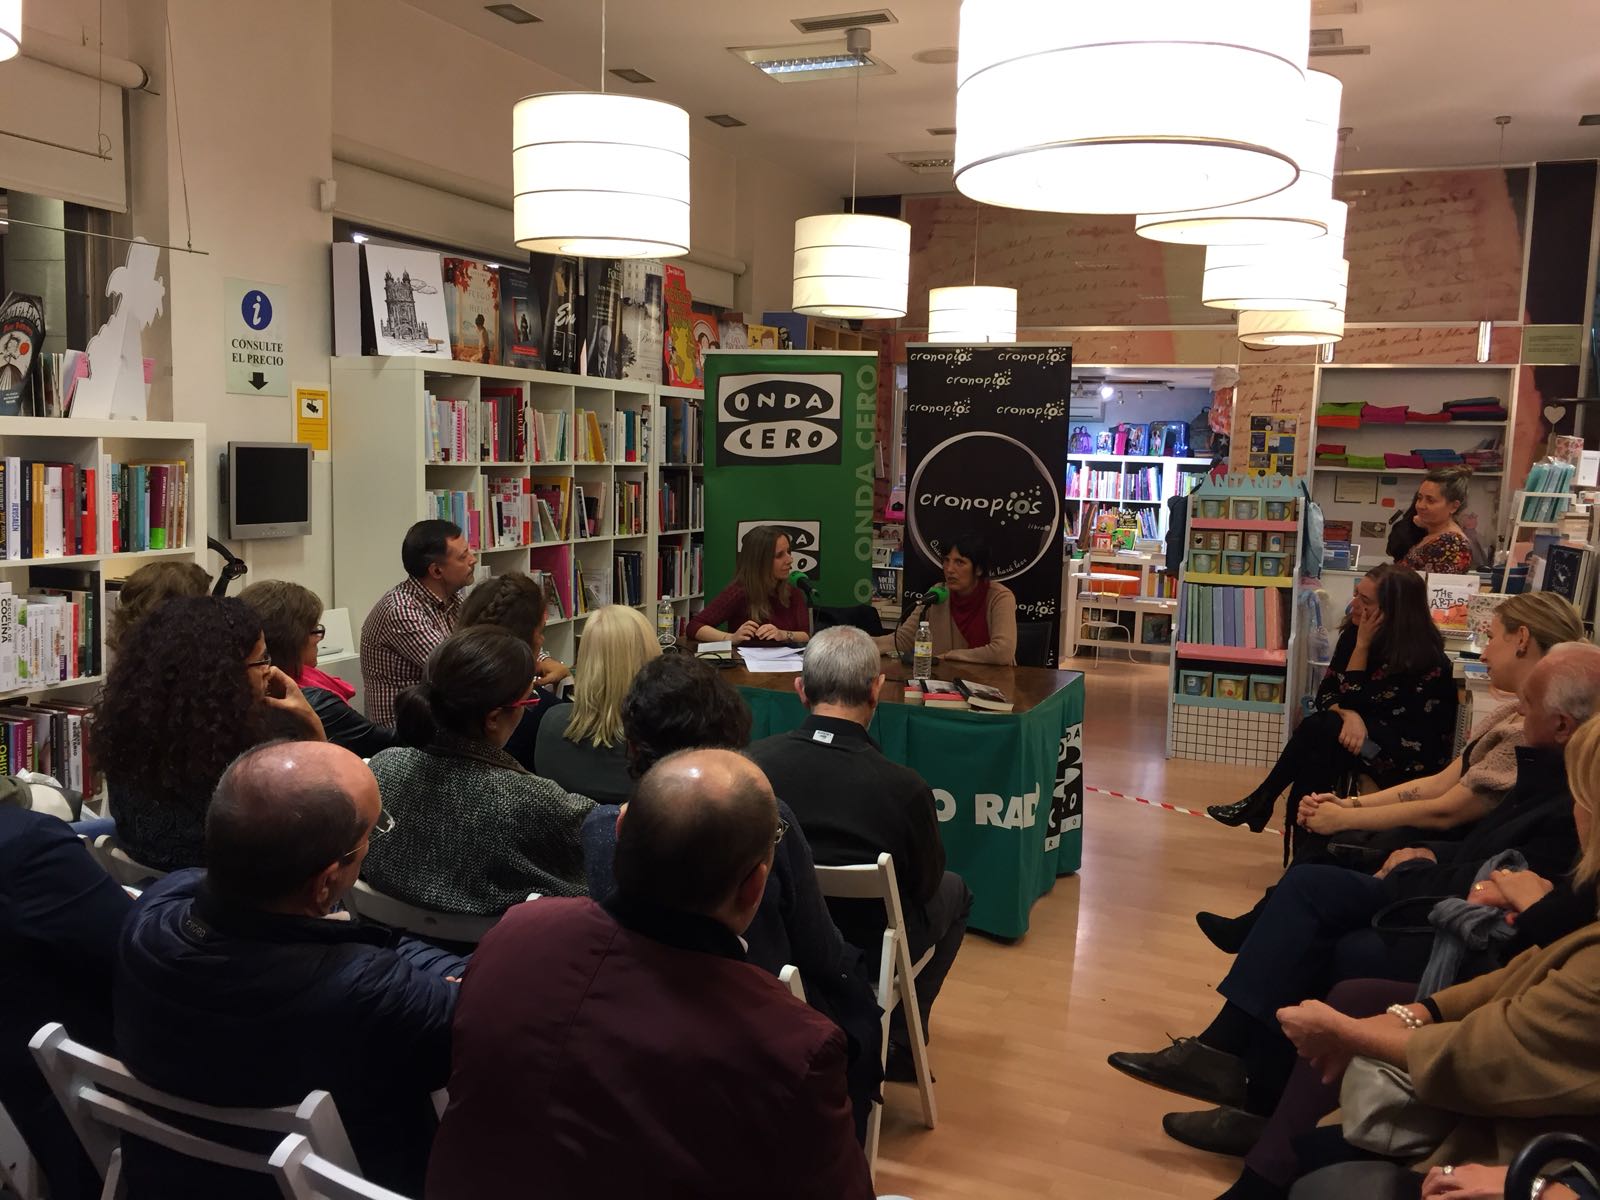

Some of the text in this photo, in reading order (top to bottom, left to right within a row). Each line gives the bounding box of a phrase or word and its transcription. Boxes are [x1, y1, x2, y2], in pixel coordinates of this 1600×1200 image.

[231, 338, 284, 353] CONSULTE
[232, 353, 284, 366] EL PRECIO
[910, 348, 974, 365] cronopios
[997, 348, 1067, 365] cronopios
[946, 371, 1013, 388] cronopios
[734, 392, 823, 412] ONDA
[909, 400, 971, 416] cronopios
[996, 402, 1065, 418] cronopios
[739, 428, 823, 450] CERO
[854, 364, 878, 561] ONDA CERO
[919, 490, 1043, 518] cronopios
[1432, 588, 1453, 599] THE
[0, 598, 8, 644] COCINA
